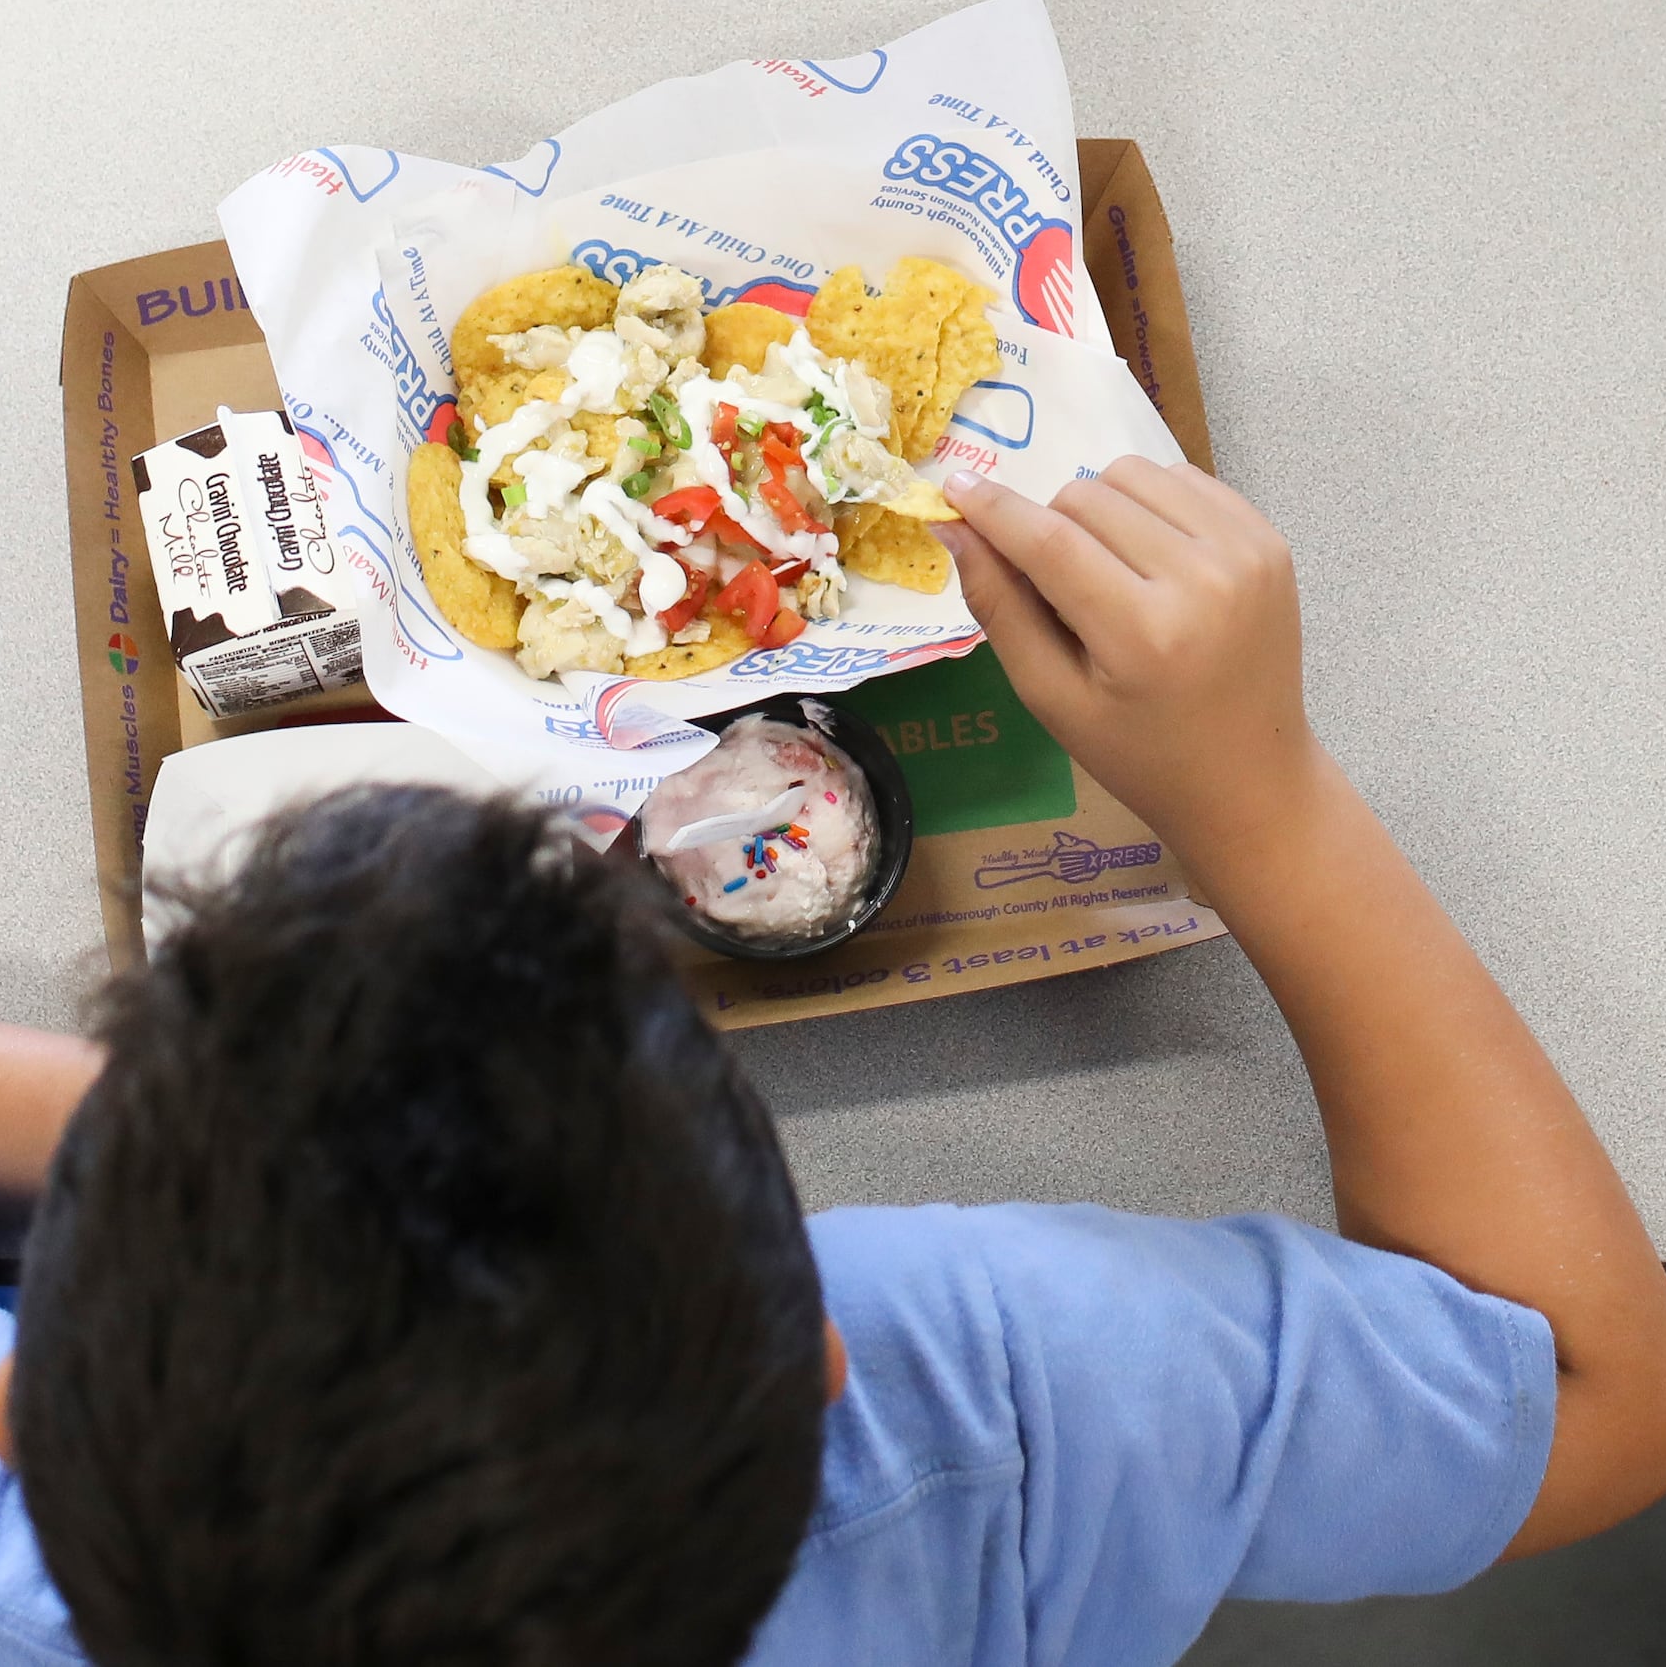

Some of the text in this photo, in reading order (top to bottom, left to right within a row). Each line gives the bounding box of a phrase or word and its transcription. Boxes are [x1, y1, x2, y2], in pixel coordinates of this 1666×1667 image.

[927, 91, 1073, 204] Child Time
[599, 193, 654, 235] Time
[883, 133, 1050, 253] PRESS
[700, 226, 771, 265] Child
[773, 249, 817, 279] One
[868, 196, 1007, 280] Hillsborough County
[1106, 202, 1142, 290] Grains
[136, 276, 251, 329] BUI
[98, 331, 130, 624] Dairy Healthy Bones
[178, 477, 219, 600] Chocolate
[205, 472, 249, 596] Cravin' Chocolate
[256, 452, 304, 572] Cravin' Chocolate
[158, 512, 195, 585] Milk
[262, 611, 333, 634] REFRIGERATED
[119, 685, 143, 796] Muscles
[1082, 841, 1163, 871] XPRESS
[919, 882, 1171, 928] Hillsborough County All Rights Reserved
[1116, 915, 1200, 946] Pick
[940, 943, 1053, 976] least
[1061, 932, 1109, 956] at
[899, 961, 933, 985] 3
